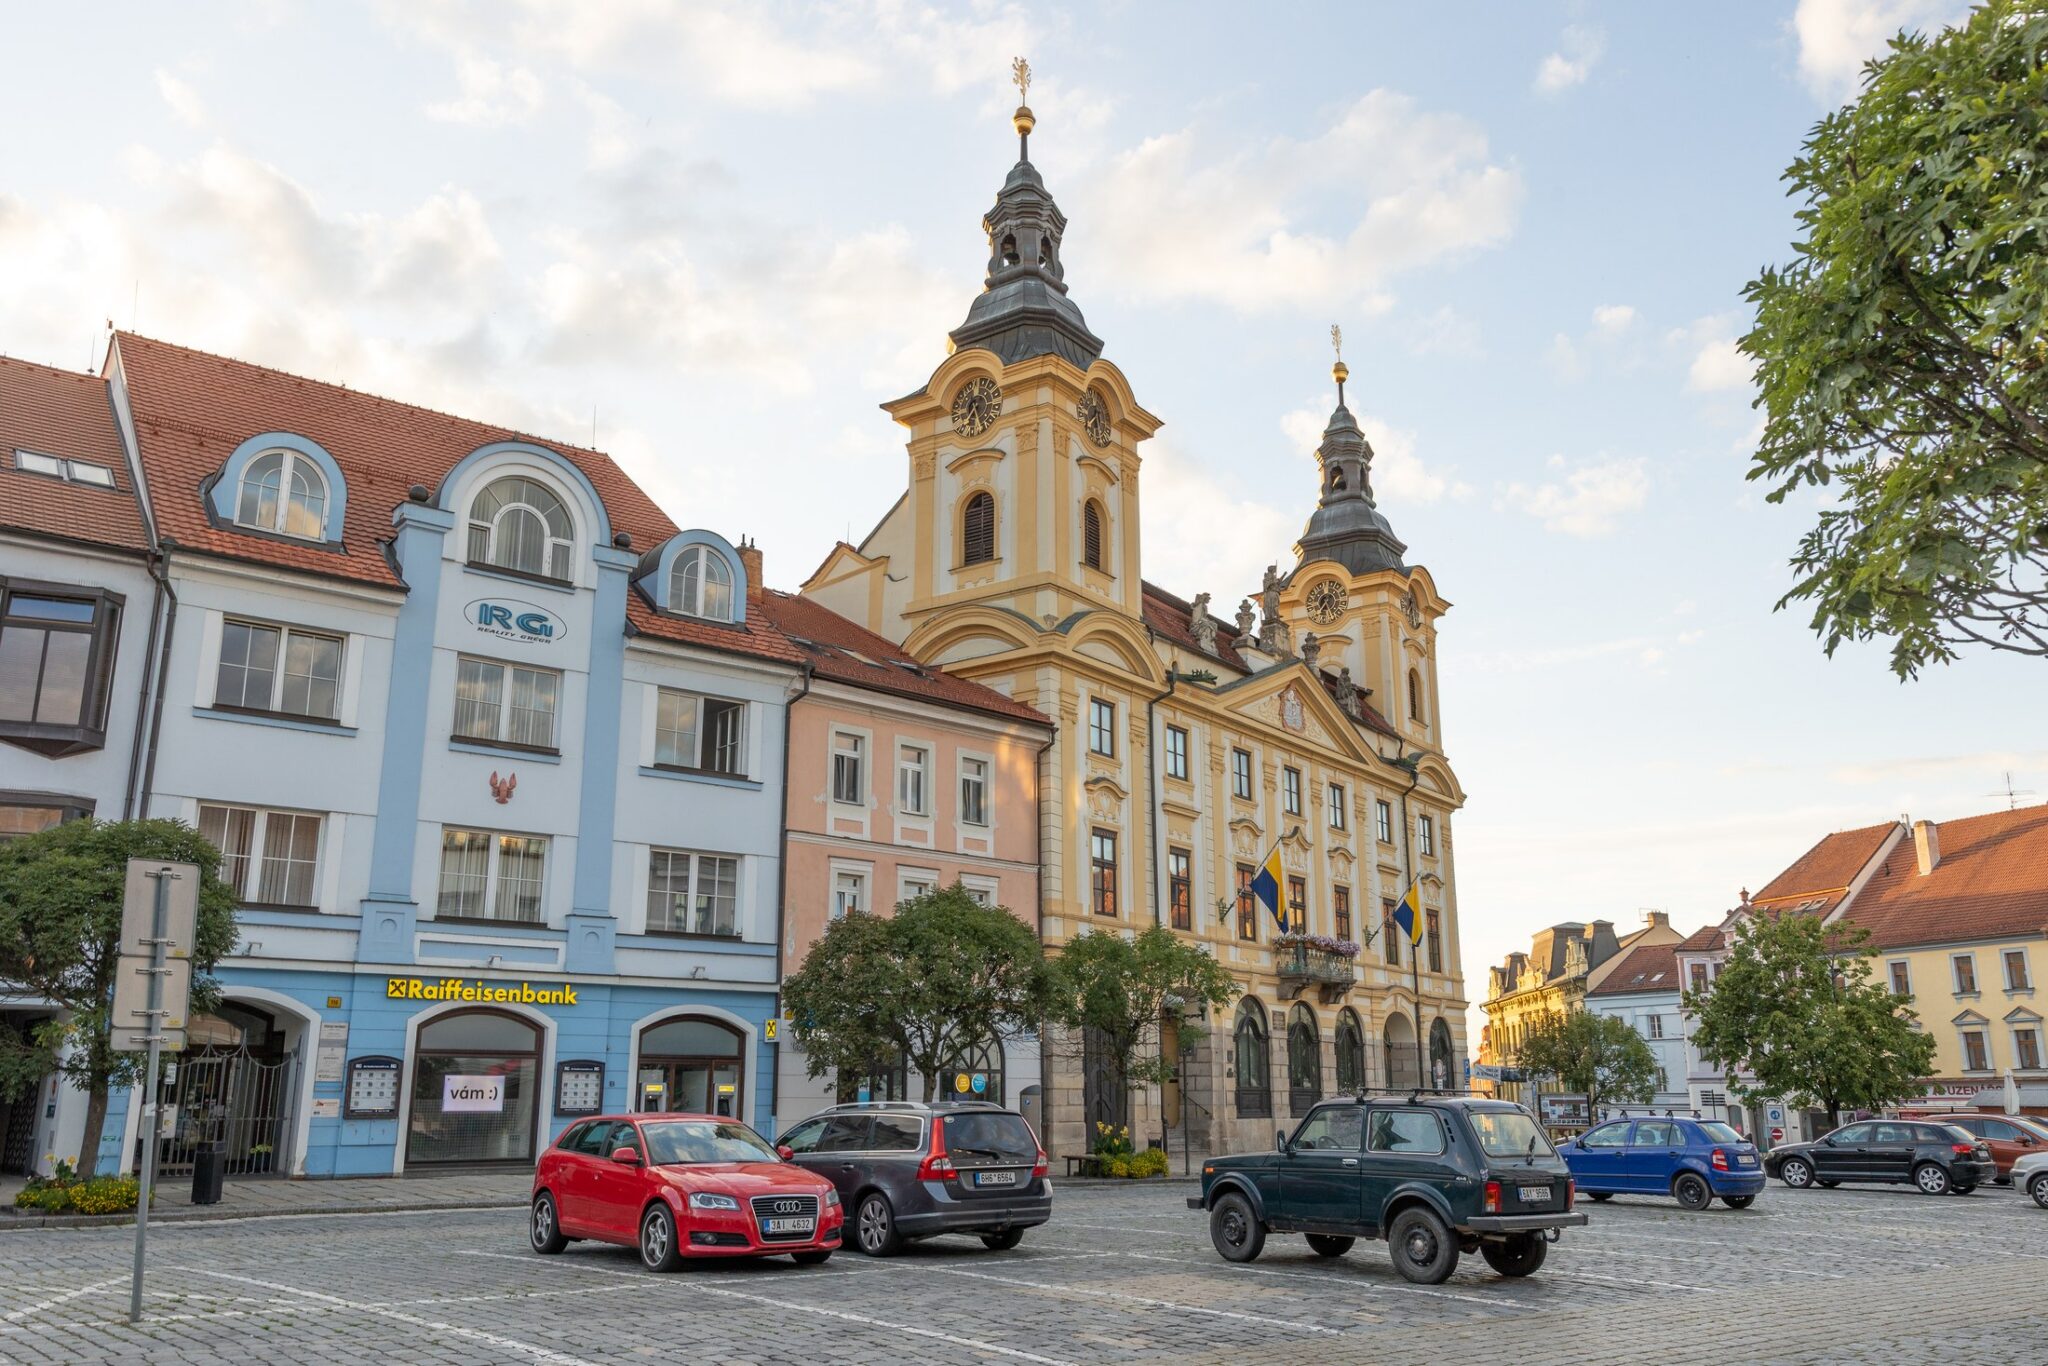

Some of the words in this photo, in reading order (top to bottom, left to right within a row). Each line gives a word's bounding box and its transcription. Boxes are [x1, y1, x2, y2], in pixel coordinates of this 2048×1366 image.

[408, 979, 578, 1005] Raiffeisenbank
[450, 1085, 484, 1100] vám
[791, 1219, 810, 1229] 4632
